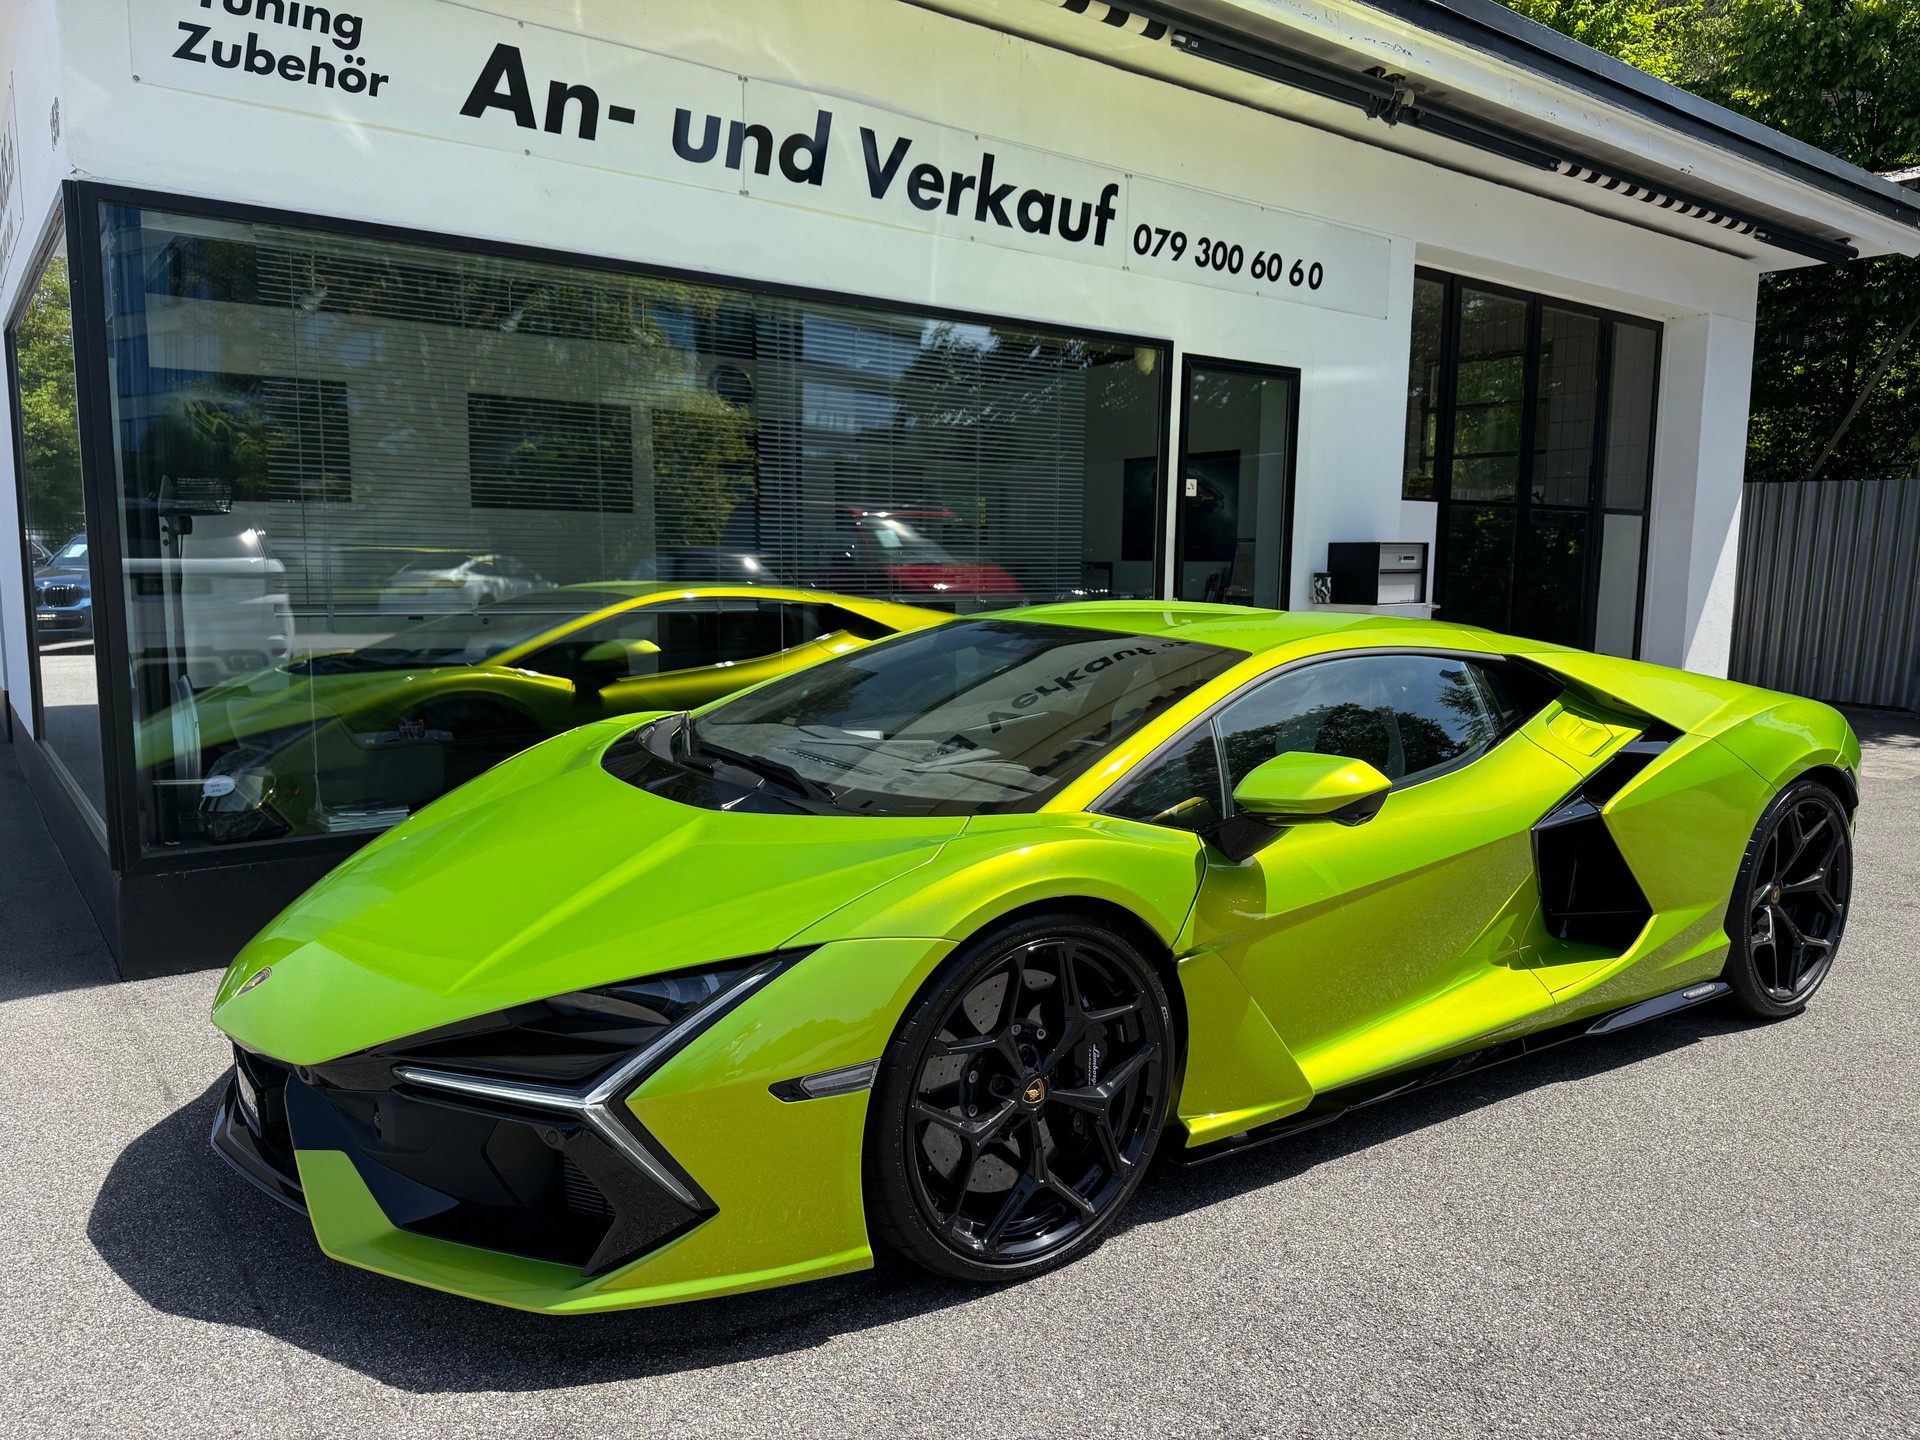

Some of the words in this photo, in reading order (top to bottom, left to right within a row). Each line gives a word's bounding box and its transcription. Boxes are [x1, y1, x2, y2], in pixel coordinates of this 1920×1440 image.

[171, 21, 389, 97] Zubehör
[199, 0, 363, 51] uning
[459, 42, 636, 141] An-
[672, 107, 833, 186] und
[859, 126, 1119, 247] Verkauf
[1133, 223, 1188, 261] 079
[1194, 237, 1244, 274] 300
[1250, 250, 1283, 282] 60
[1289, 259, 1324, 291] 60
